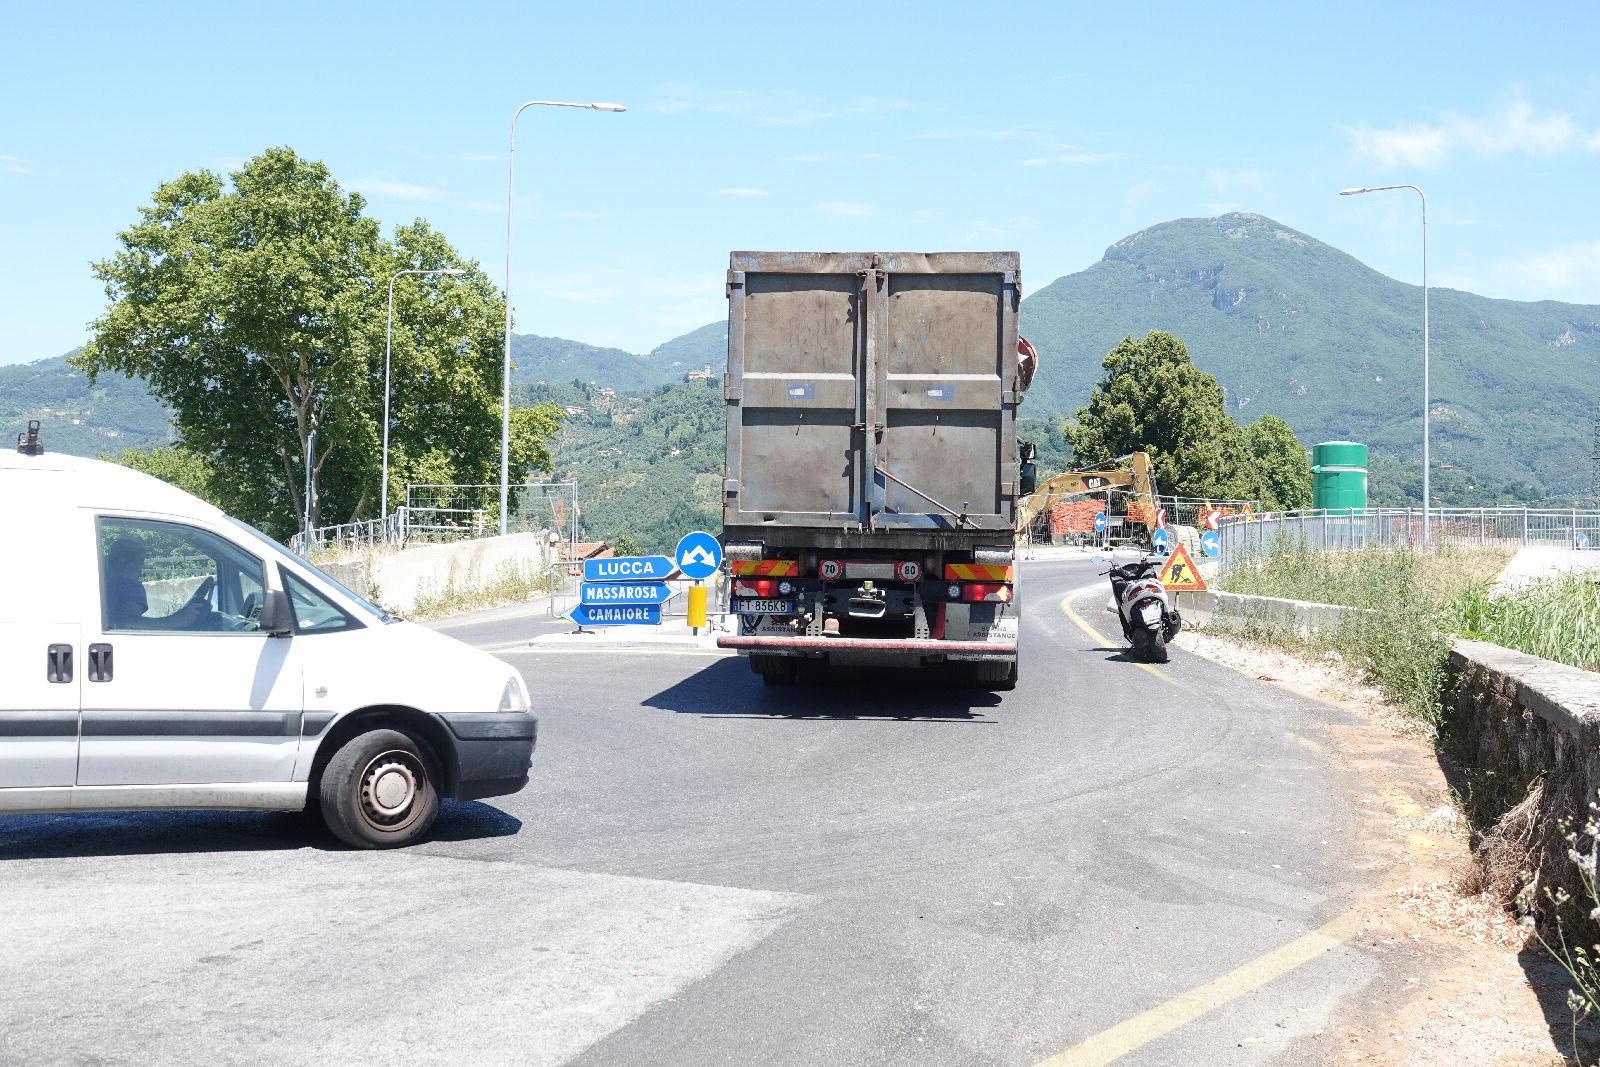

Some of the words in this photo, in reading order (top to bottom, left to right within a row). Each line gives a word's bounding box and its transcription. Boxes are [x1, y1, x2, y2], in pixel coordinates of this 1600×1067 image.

[1088, 477, 1101, 489] CAT
[598, 561, 655, 576] LUCCA
[824, 564, 836, 574] 70
[904, 565, 916, 575] 80
[586, 586, 658, 600] MASSAROSA
[588, 607, 650, 621] CAMAIORE
